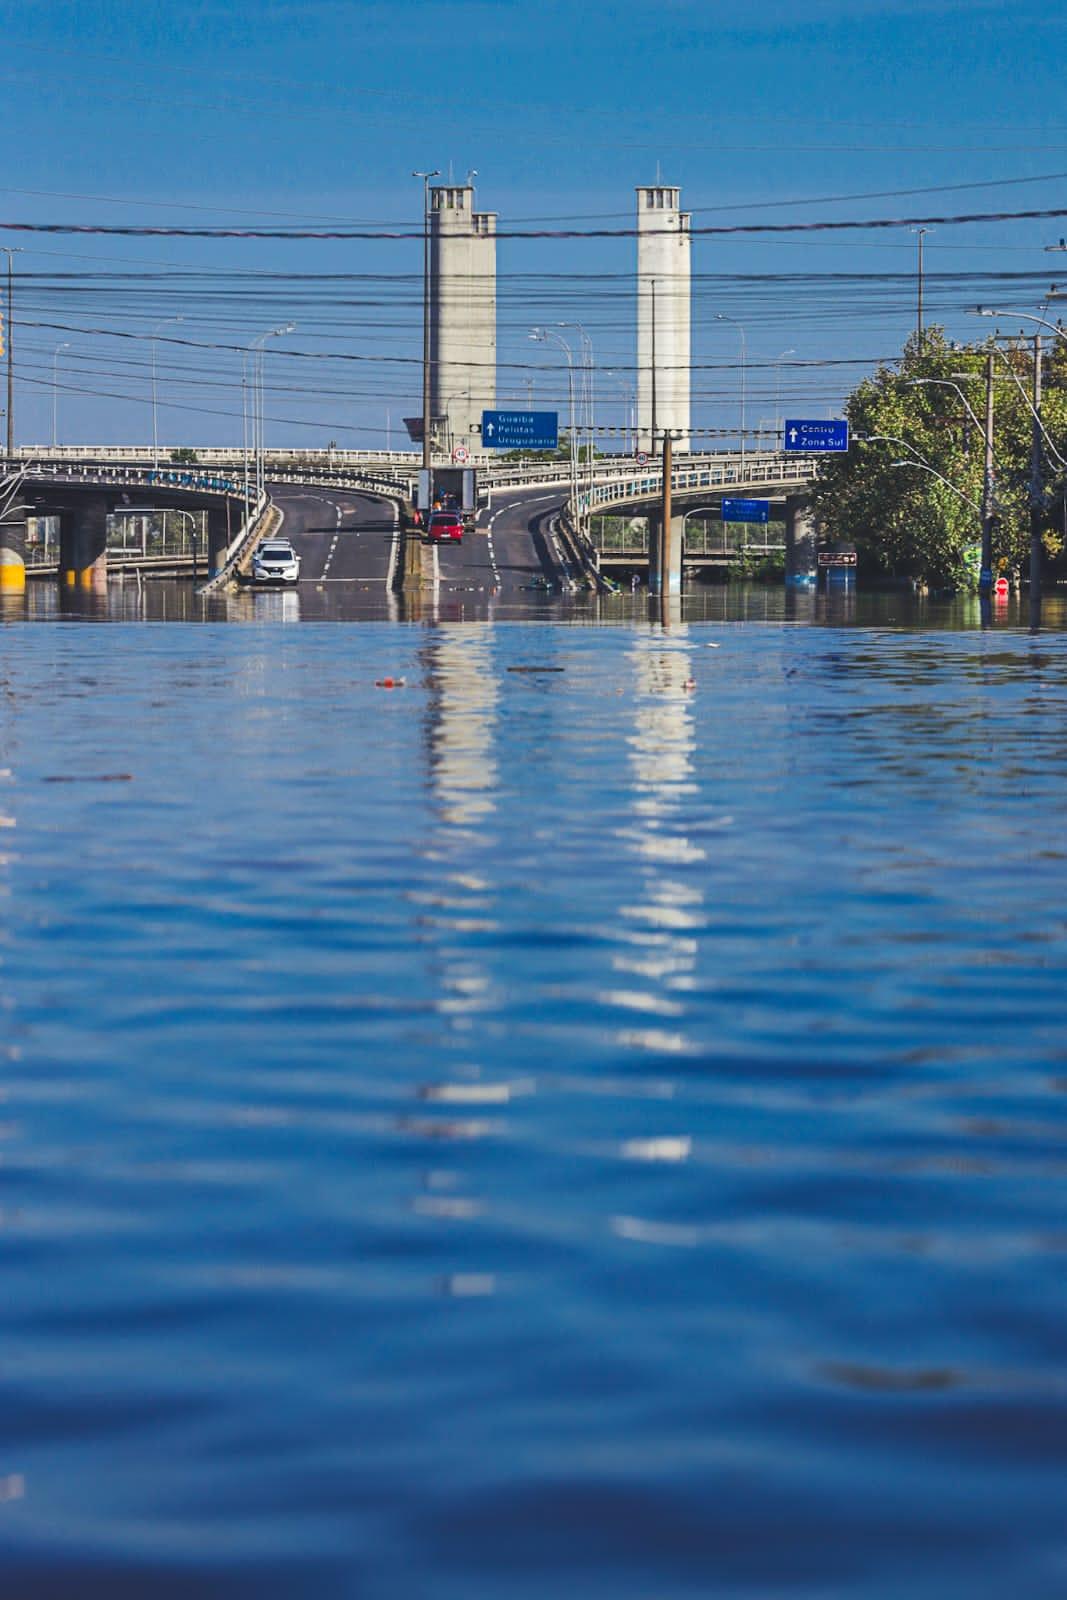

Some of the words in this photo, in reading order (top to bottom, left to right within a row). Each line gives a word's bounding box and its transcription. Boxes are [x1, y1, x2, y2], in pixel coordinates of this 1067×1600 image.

[498, 425, 535, 434] Pelotas
[801, 438, 826, 447] Zona
[828, 438, 844, 447] Sul
